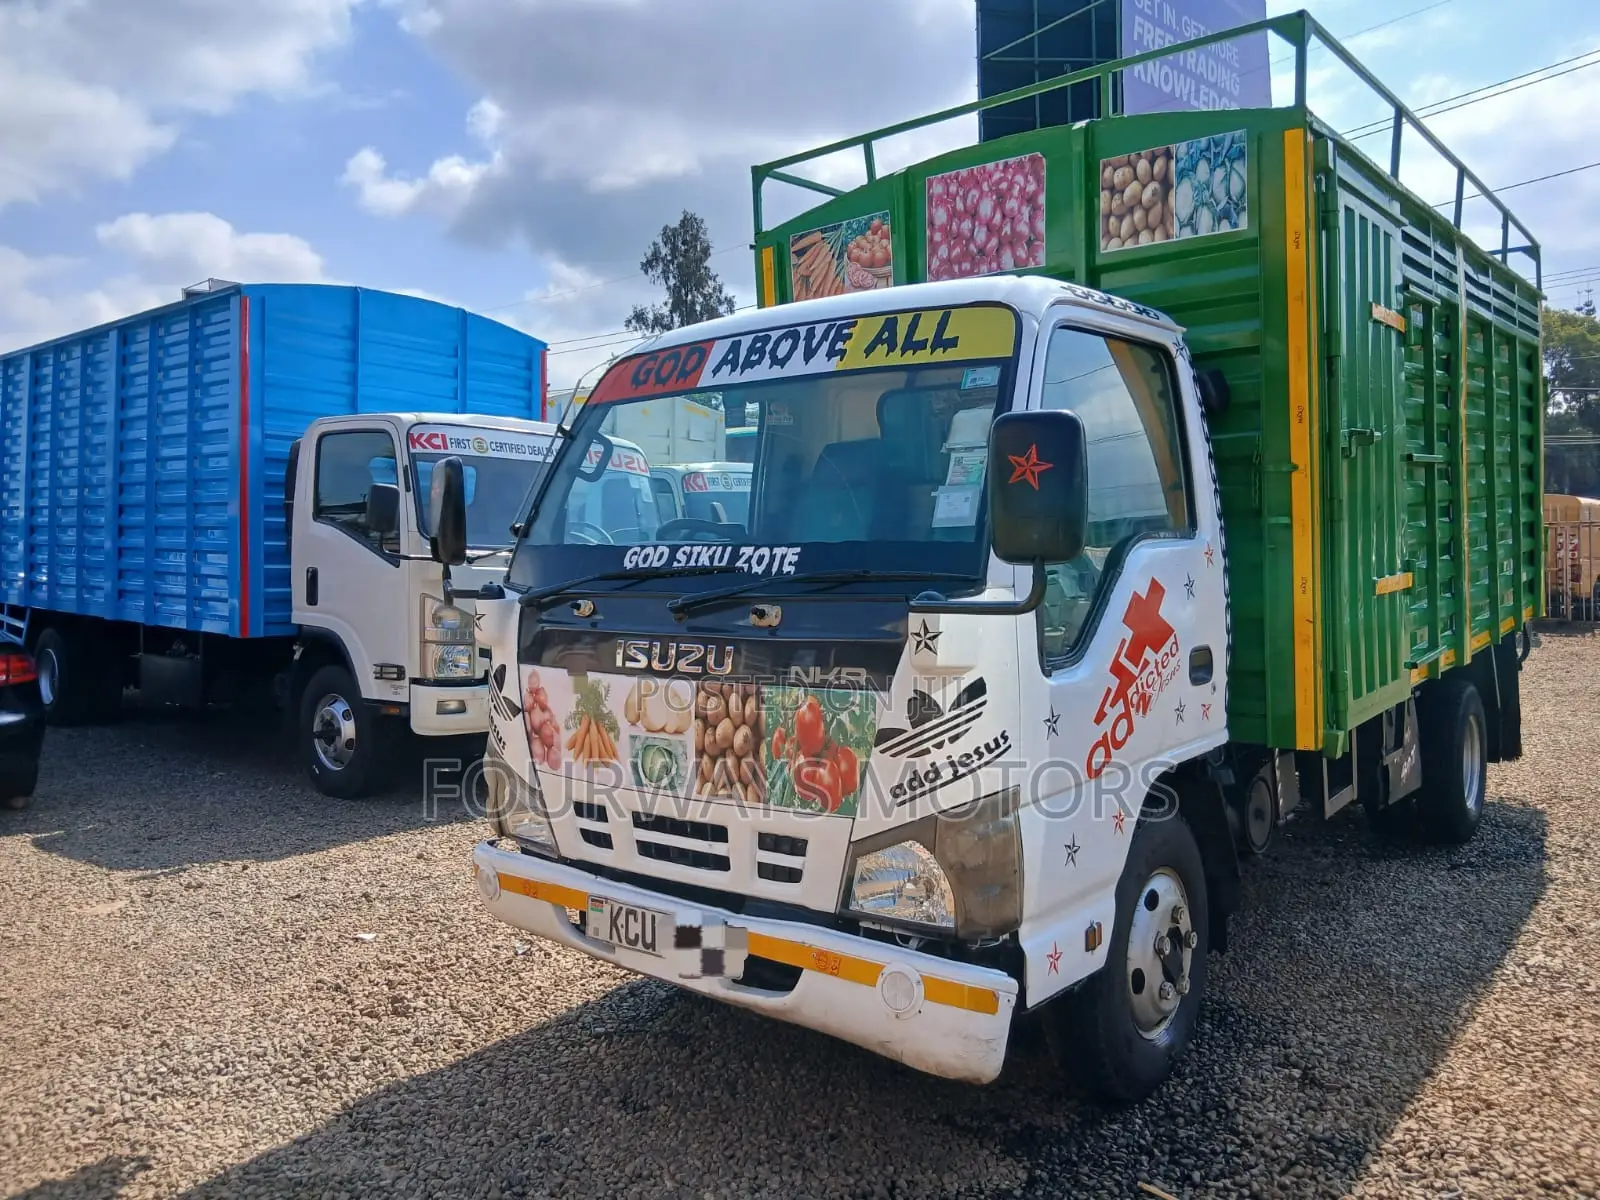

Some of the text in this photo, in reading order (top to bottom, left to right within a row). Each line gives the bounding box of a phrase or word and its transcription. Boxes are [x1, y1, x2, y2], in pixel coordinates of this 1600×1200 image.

[1134, 50, 1238, 109] KNOWLED
[631, 310, 960, 391] GOD ABOVE ALL
[408, 432, 449, 450] KCI
[449, 437, 473, 451] FIRST
[489, 441, 527, 455] CERTIFIED
[623, 545, 801, 576] GOD SIKU ZOTE
[614, 638, 735, 676] ISUZU
[790, 665, 868, 686] NKR
[889, 729, 1010, 799] add jesus
[608, 903, 657, 952] KCU
